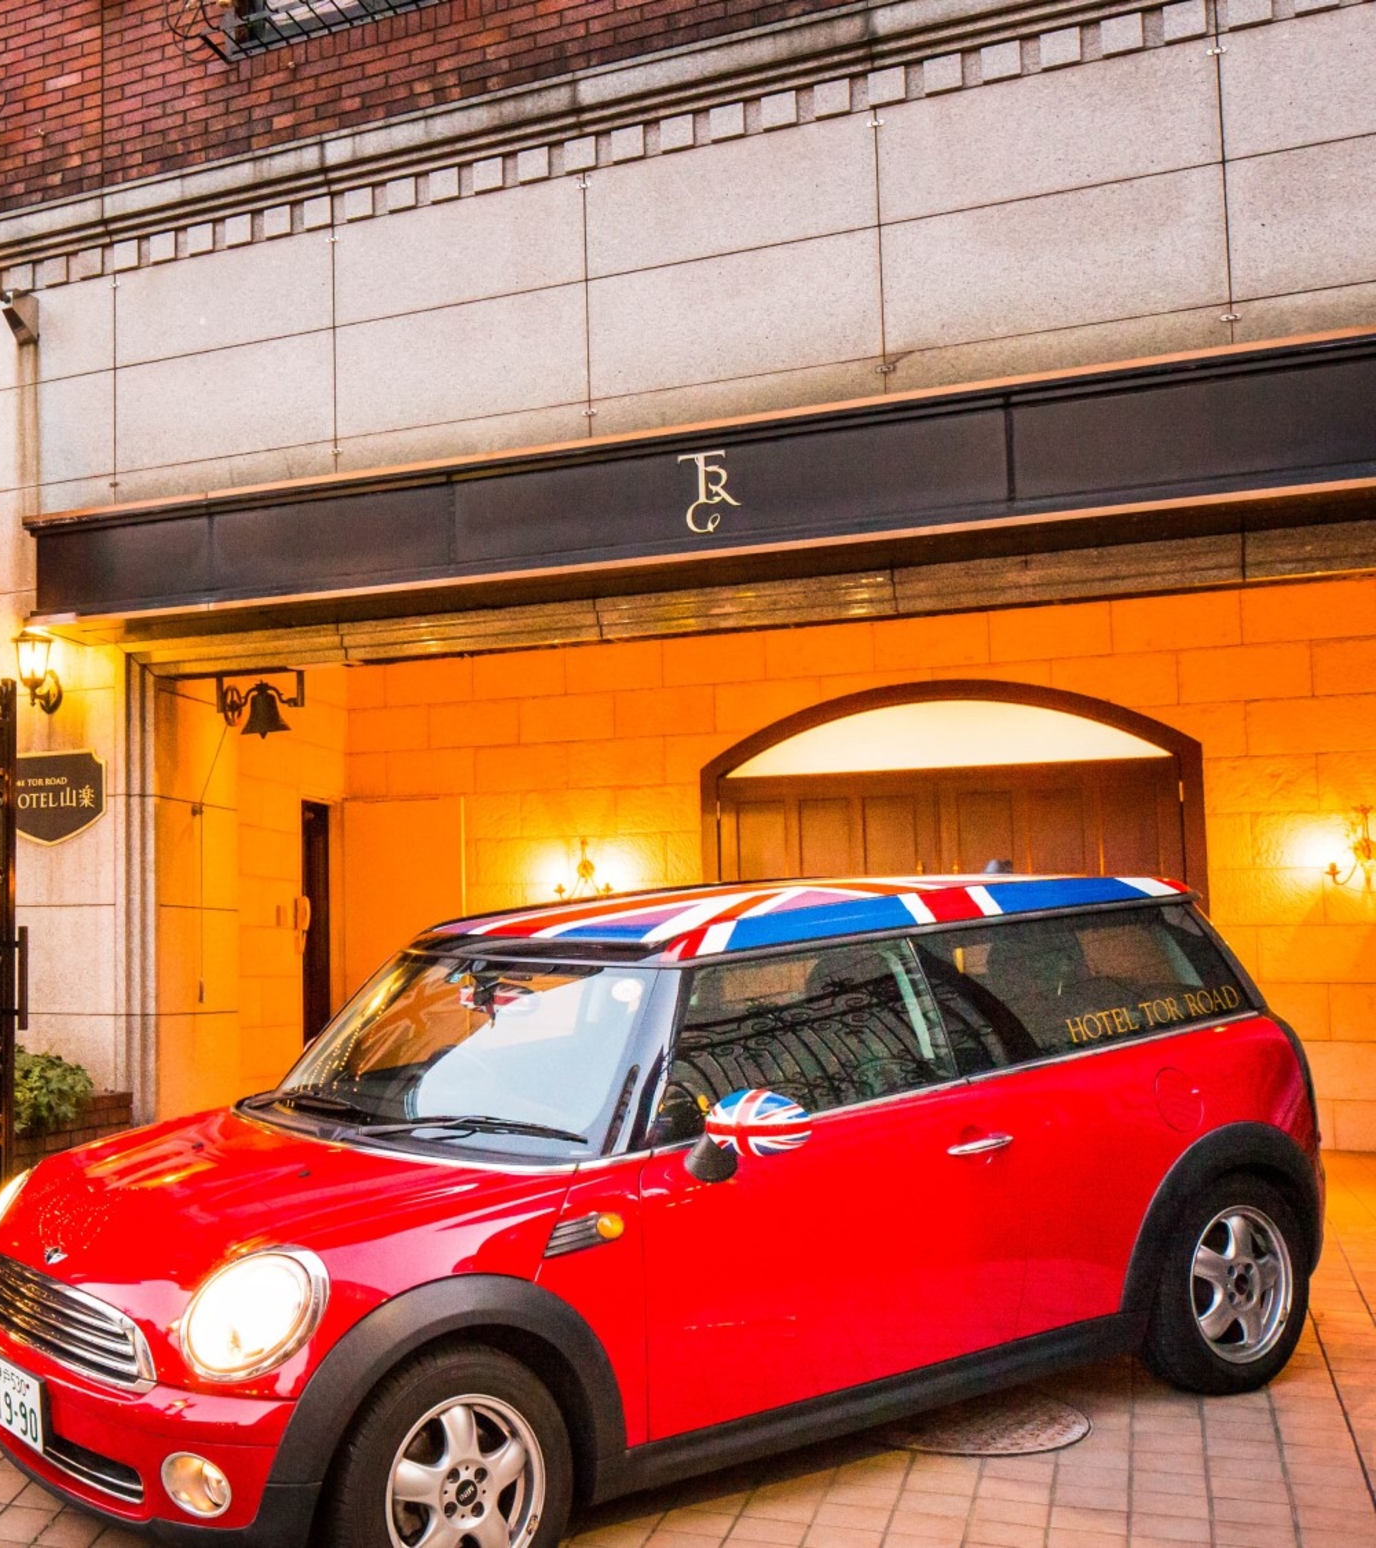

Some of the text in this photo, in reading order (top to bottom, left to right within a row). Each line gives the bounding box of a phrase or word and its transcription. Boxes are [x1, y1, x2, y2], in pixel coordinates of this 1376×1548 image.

[27, 778, 44, 787] TOR
[45, 776, 68, 786] ROAD
[1065, 984, 1240, 1043] HOTEL TOR ROAD
